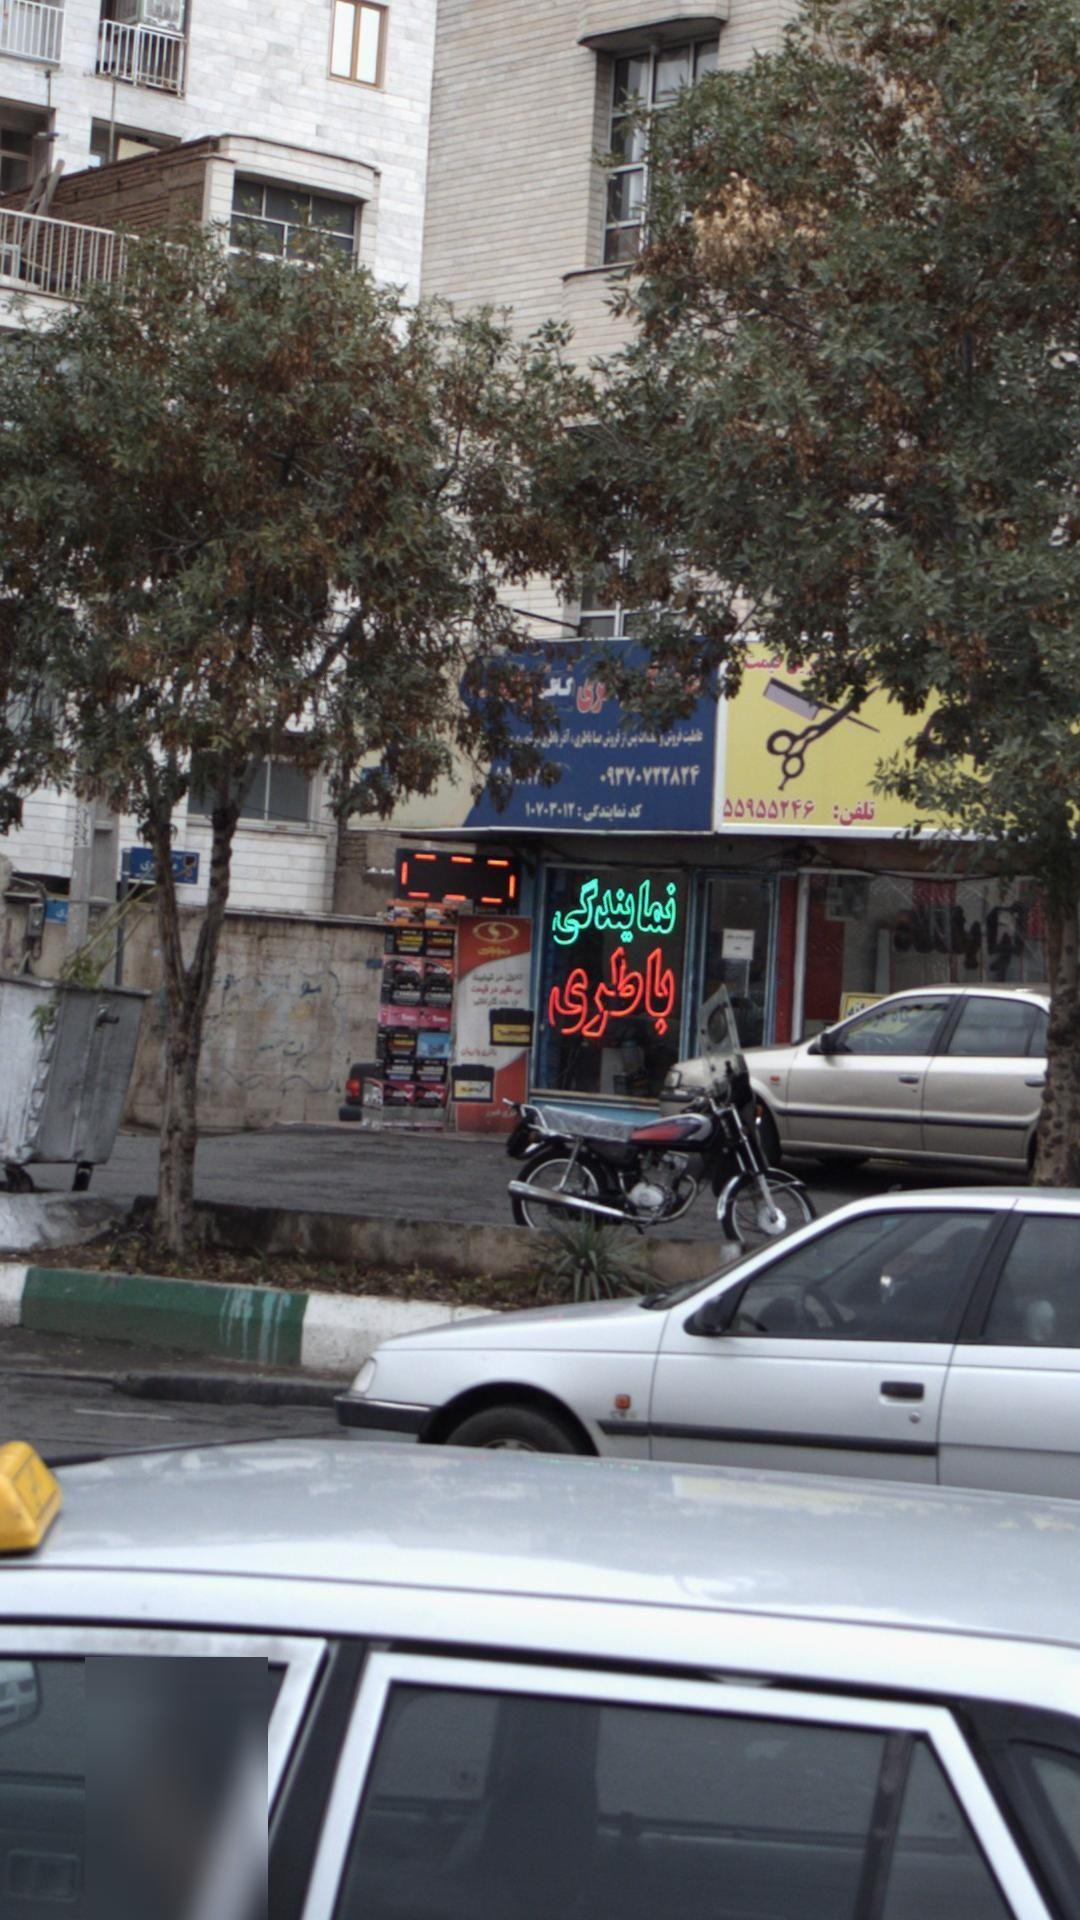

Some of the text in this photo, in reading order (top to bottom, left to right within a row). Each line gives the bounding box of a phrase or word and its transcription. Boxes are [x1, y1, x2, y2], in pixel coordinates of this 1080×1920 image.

[628, 803, 643, 818] کد
[723, 798, 815, 820] ۵۵۹۵۵۲۴۶
[552, 878, 677, 945] نمایندگی
[549, 946, 675, 1038] باطری
